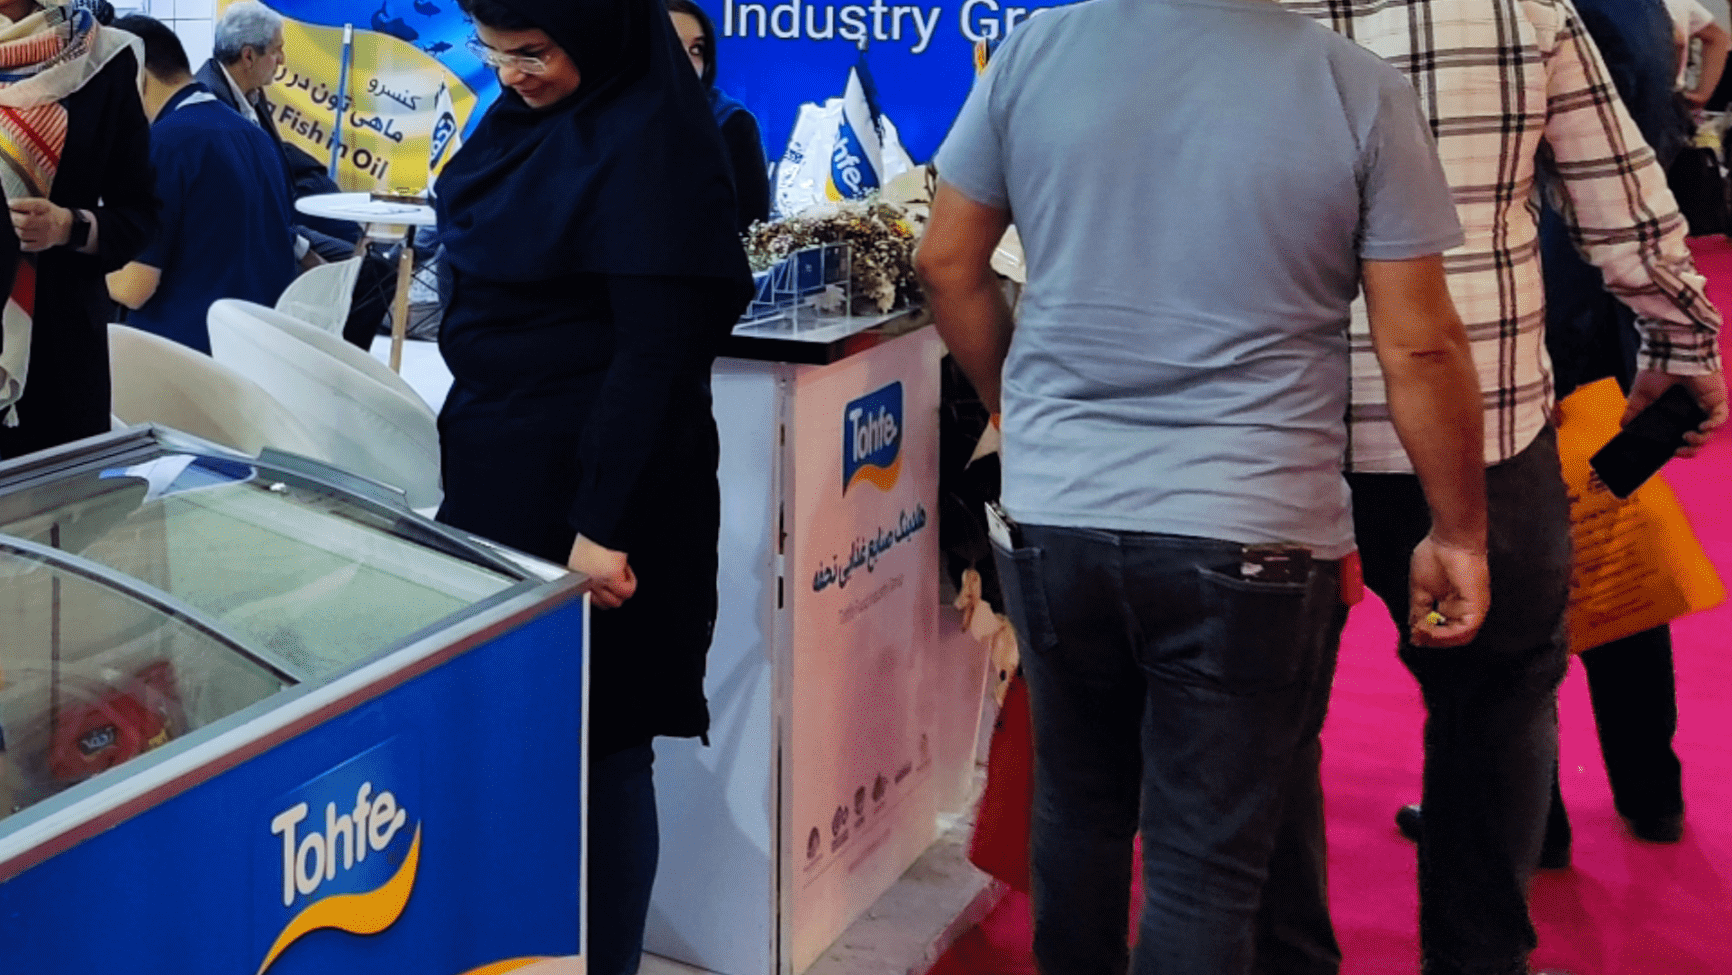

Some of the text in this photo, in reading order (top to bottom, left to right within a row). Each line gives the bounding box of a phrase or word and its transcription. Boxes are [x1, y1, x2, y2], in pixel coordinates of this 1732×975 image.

[367, 78, 423, 112] کنسرو
[278, 105, 324, 145] Fish
[352, 148, 389, 180] Oil
[349, 110, 405, 144] ماهی
[849, 405, 898, 463] Tohfe
[271, 781, 406, 907] Tohfe
